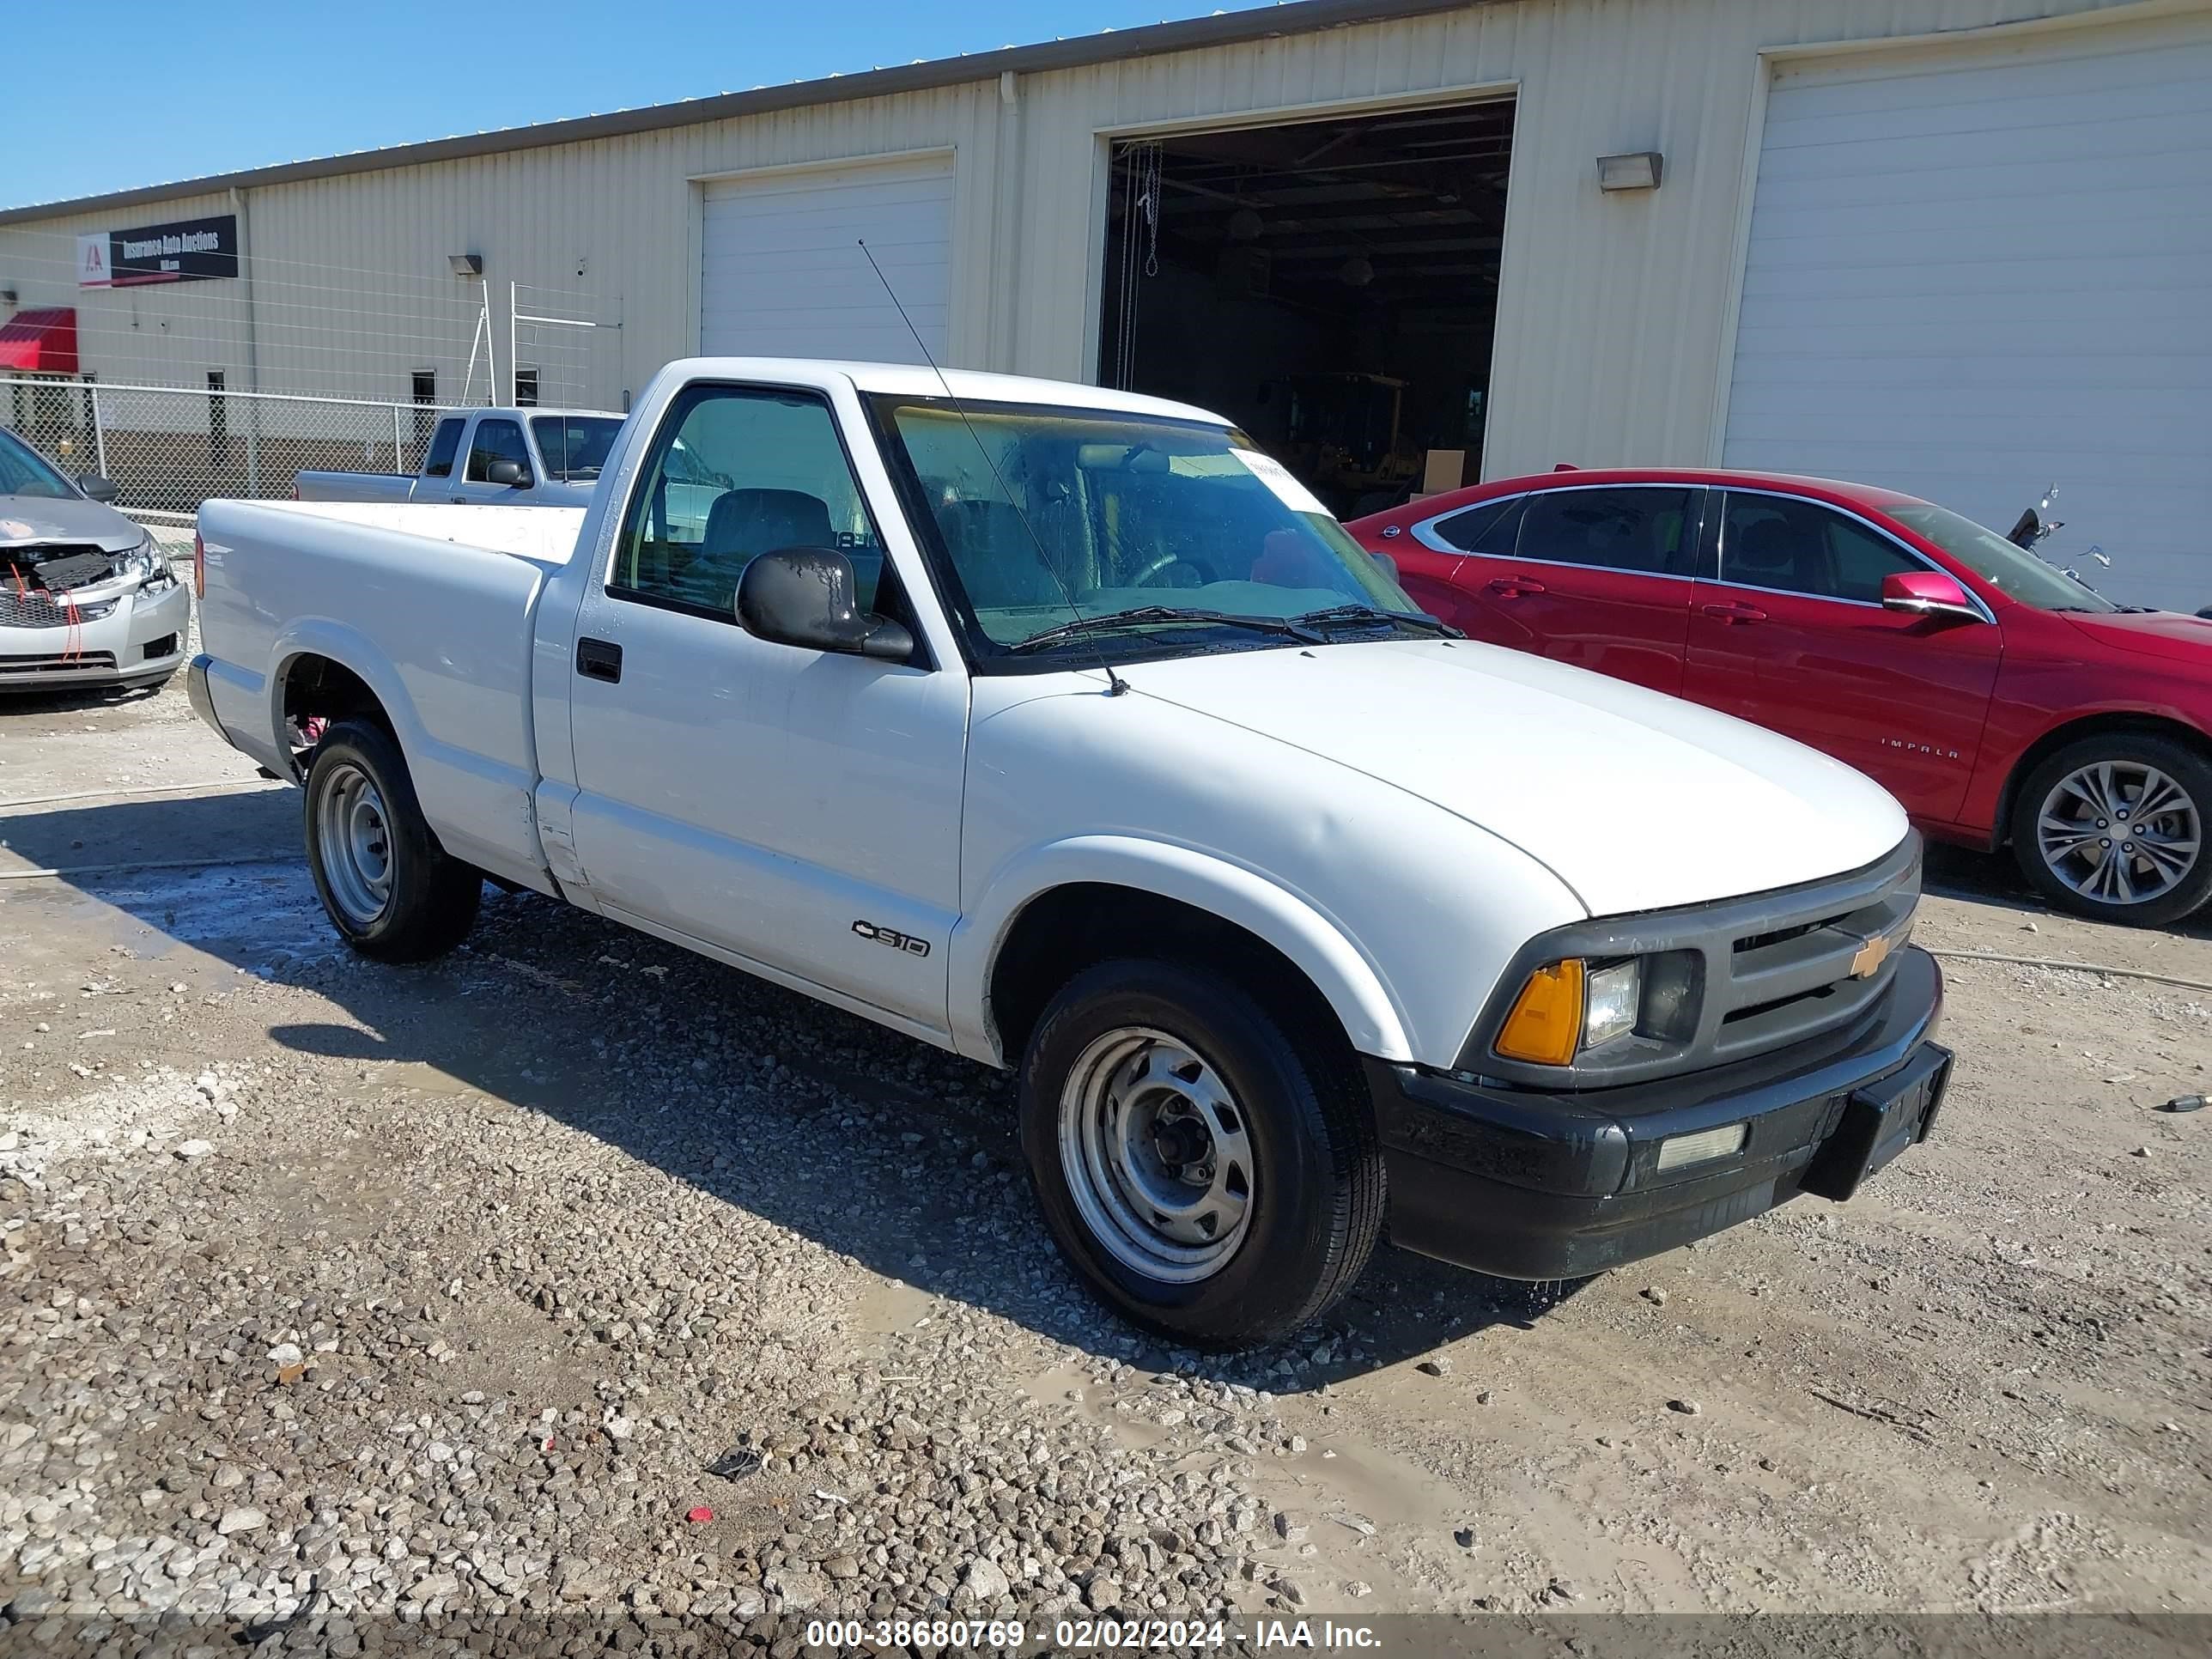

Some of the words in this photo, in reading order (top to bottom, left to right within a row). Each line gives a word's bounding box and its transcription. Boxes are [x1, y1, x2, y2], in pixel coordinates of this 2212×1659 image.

[123, 240, 162, 259] Insurance
[162, 234, 181, 255] Auto
[182, 230, 219, 253] Auctions
[1881, 738, 1960, 759] IMPALA
[877, 927, 932, 957] S10
